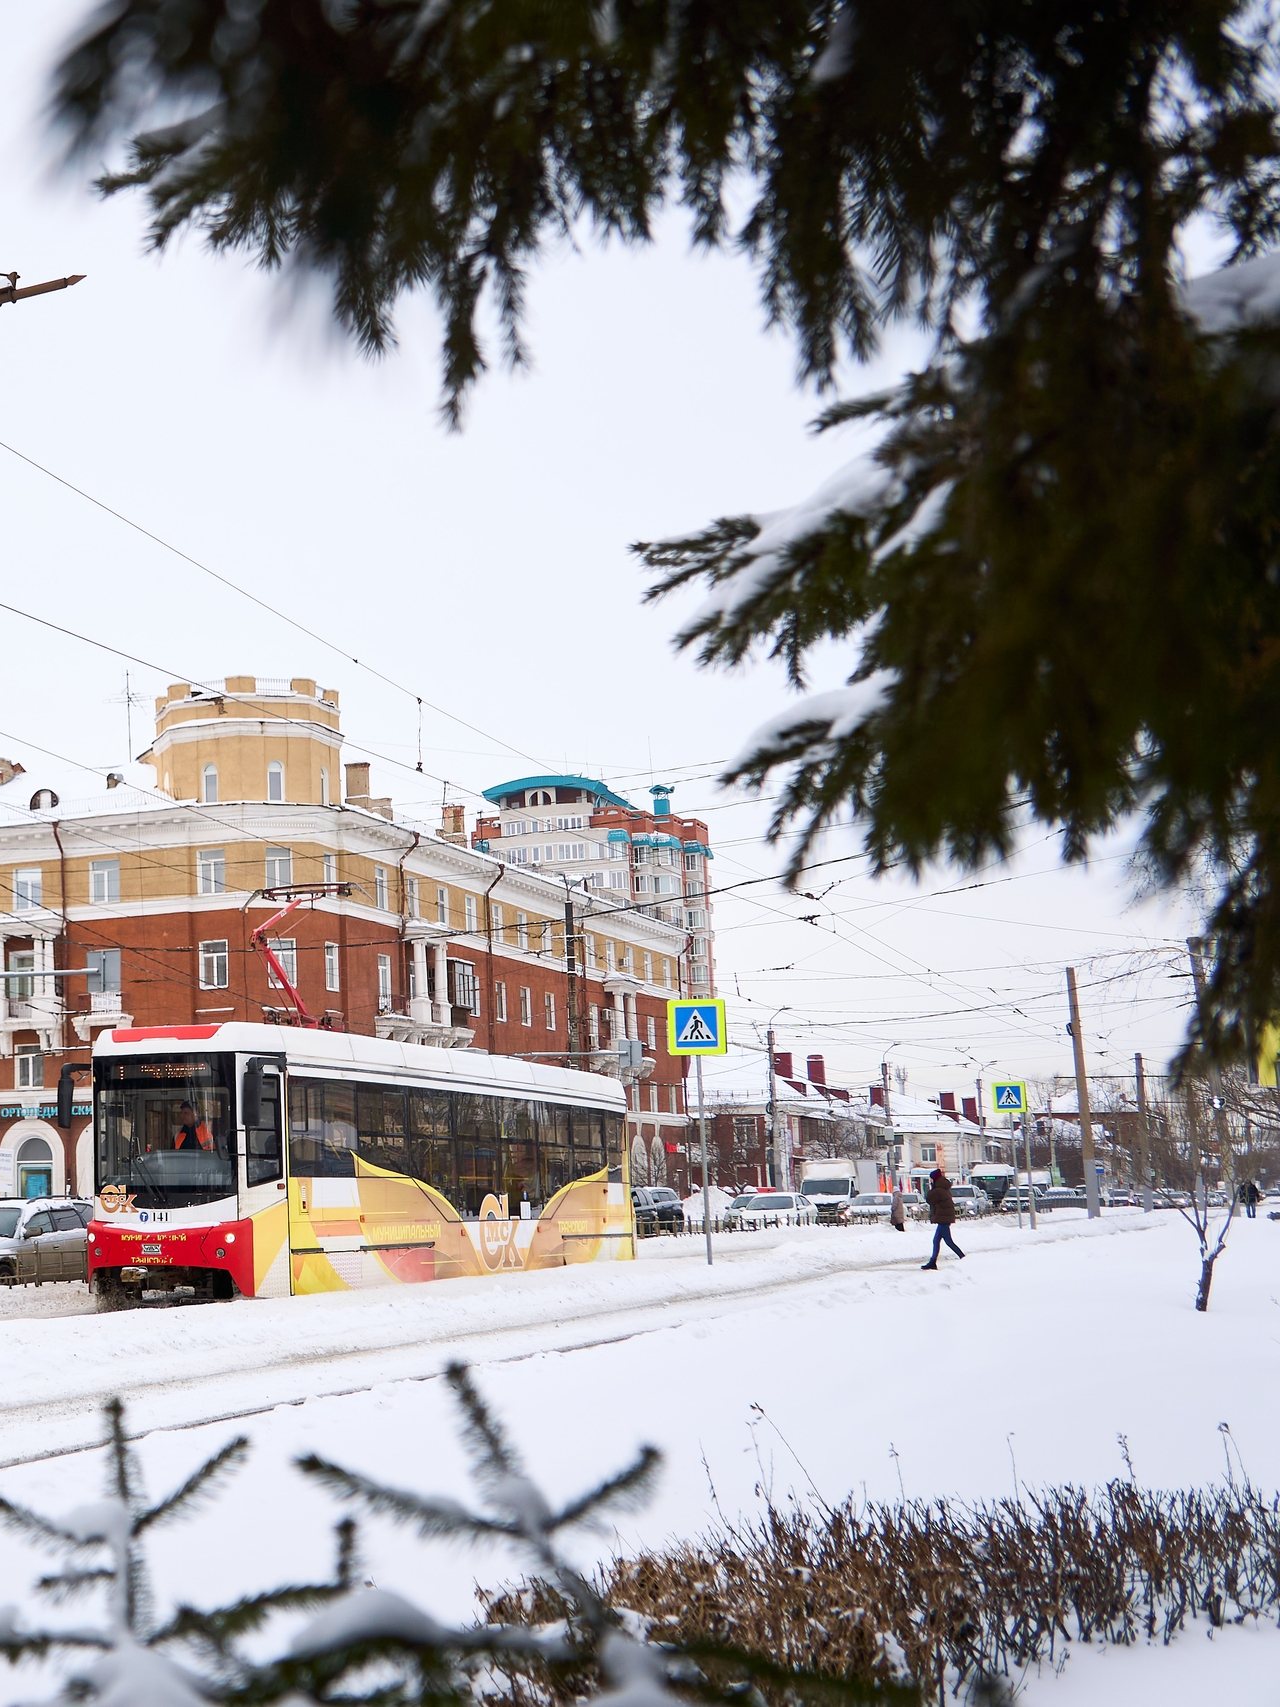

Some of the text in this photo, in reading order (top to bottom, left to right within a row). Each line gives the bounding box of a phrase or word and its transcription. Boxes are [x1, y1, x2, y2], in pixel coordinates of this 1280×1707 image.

[152, 1212, 169, 1222] 141
[372, 1220, 442, 1241] МУНИЦИПАЛЬНЫЙ
[558, 1220, 589, 1233] ТРАНСПОРТ
